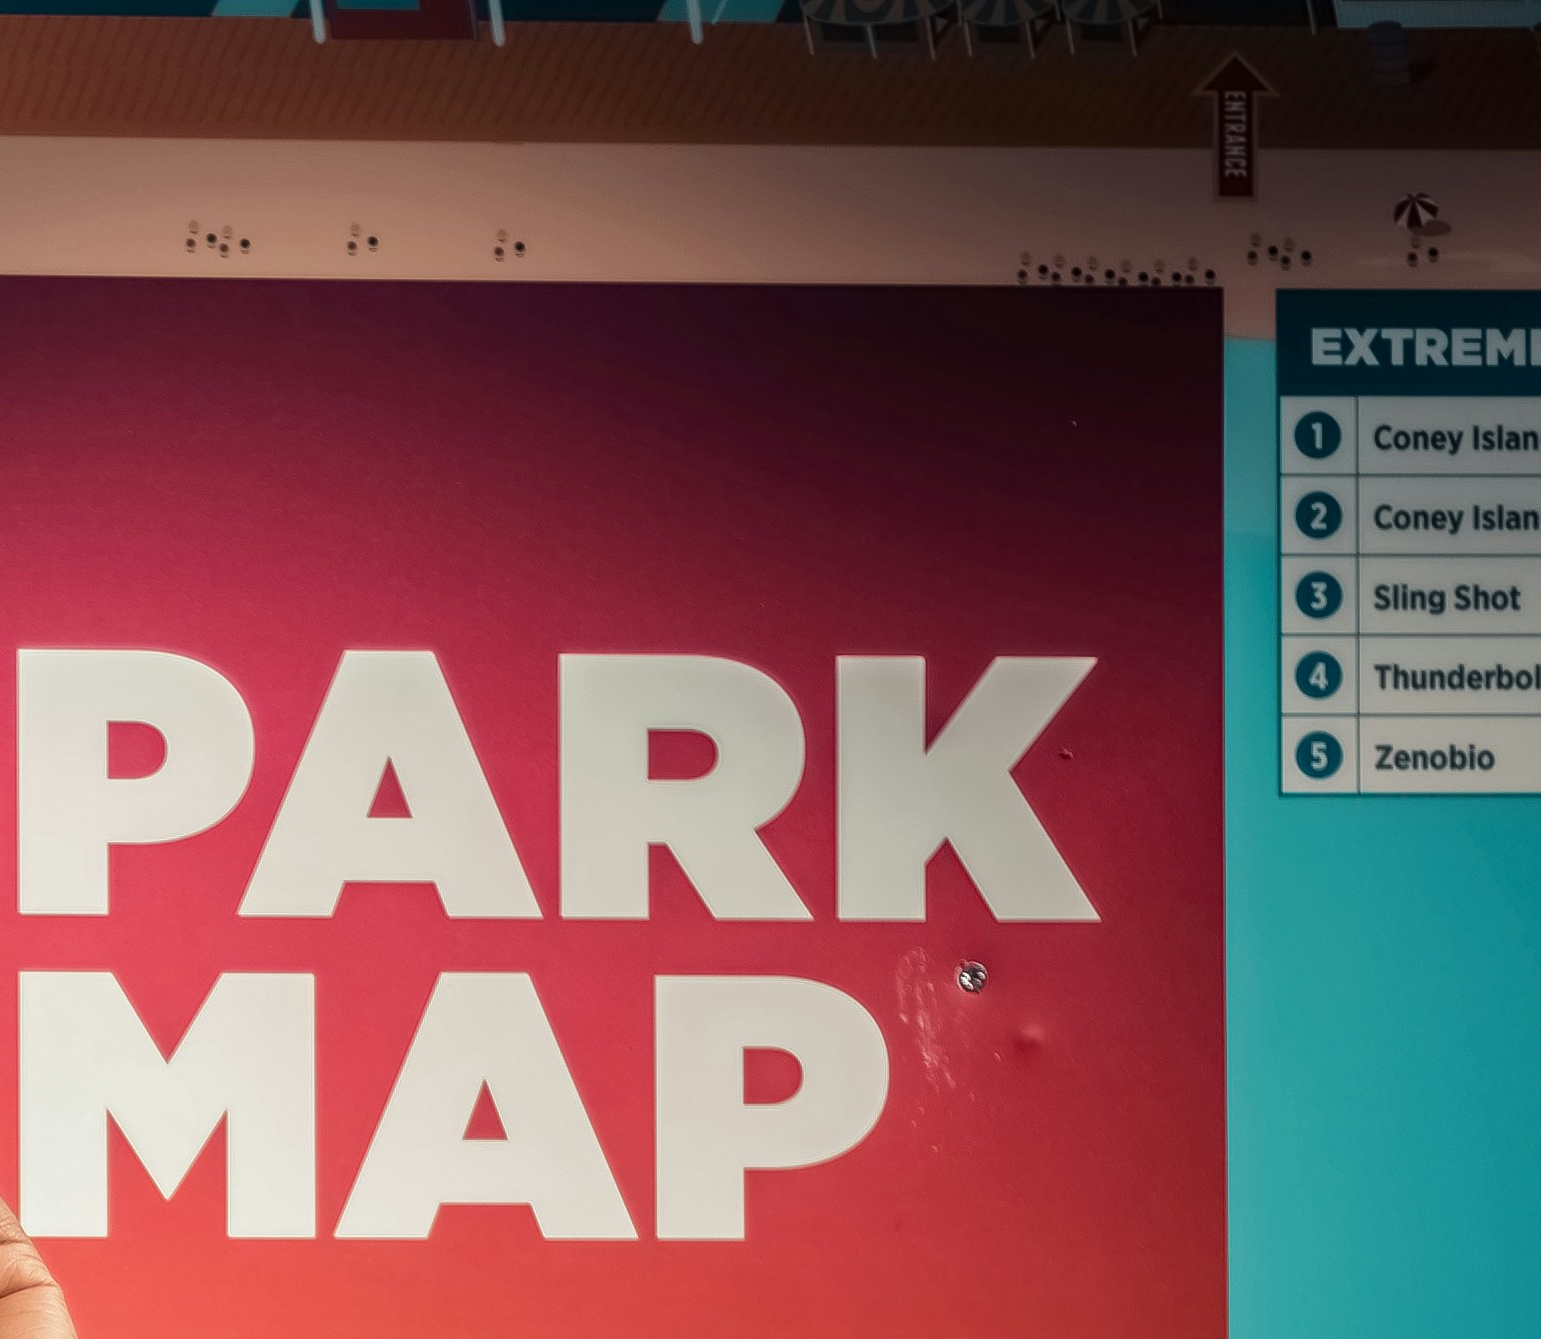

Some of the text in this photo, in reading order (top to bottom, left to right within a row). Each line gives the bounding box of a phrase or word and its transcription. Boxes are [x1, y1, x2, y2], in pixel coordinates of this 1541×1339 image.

[1224, 90, 1248, 178] ENTRANCE
[1311, 422, 1541, 455] 1 Coney Islan
[1310, 502, 1541, 535] 2 Coney Islan
[1310, 582, 1522, 616] 3 Sling Shot
[1309, 662, 1329, 690] 4
[1310, 742, 1496, 771] 5 Zenobio
[16, 647, 1101, 923] PARK
[18, 970, 890, 1242] MAP
